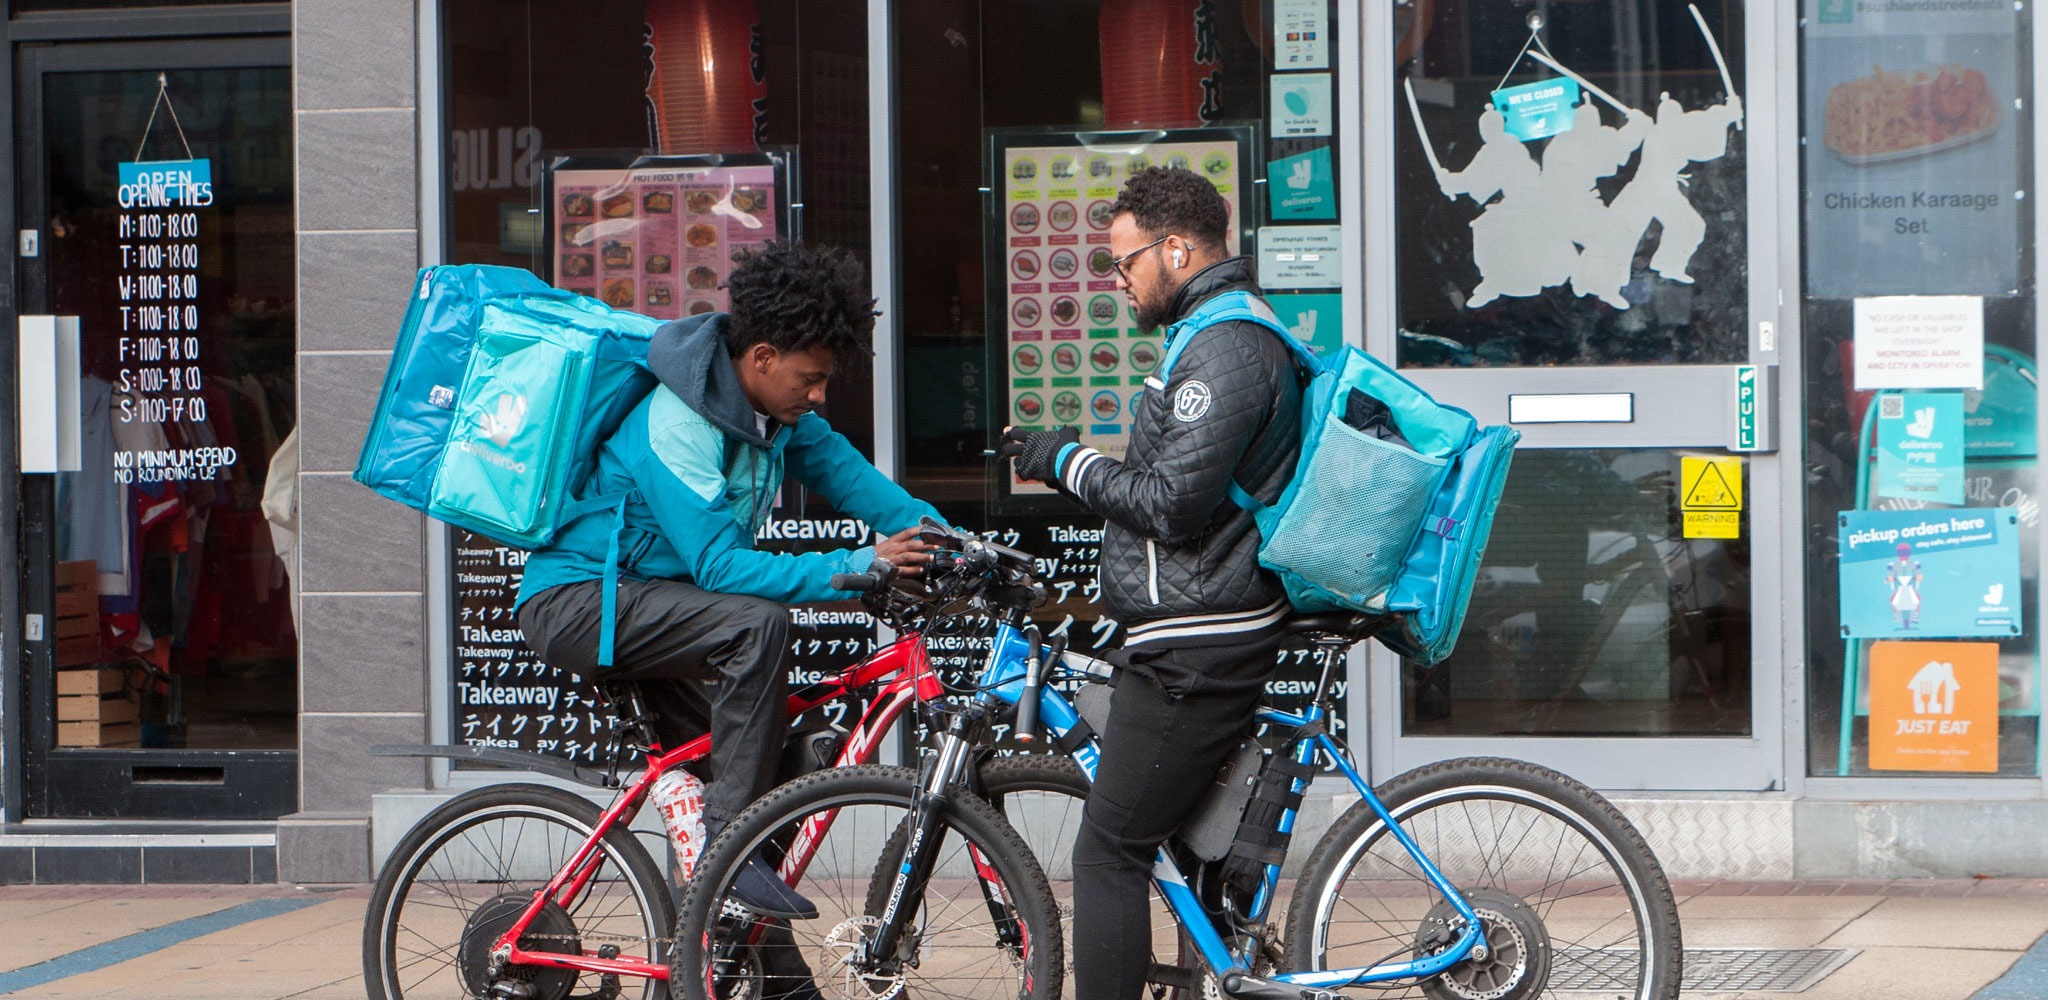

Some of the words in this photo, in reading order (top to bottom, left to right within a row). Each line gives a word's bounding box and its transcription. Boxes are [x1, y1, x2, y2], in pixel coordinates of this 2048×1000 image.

[138, 170, 192, 188] OPEN
[653, 173, 674, 181] FOOD
[1824, 191, 1906, 211] Chicken
[1912, 190, 1999, 212] Karaage
[1894, 217, 1929, 235] Set
[1869, 314, 1881, 322] NO
[1883, 314, 1906, 322] CASH
[1922, 313, 1969, 321] VALUABLES
[1891, 326, 1910, 334] LEFT
[1940, 325, 1963, 333] SHOP
[1892, 337, 1942, 346] OVERNIGHT
[1875, 350, 1929, 358] MONITORED
[1930, 349, 1962, 357] ALARM
[1866, 362, 1886, 370] AND
[1887, 362, 1909, 370] CCTV
[1921, 360, 1971, 369] OPERATION
[1180, 388, 1204, 416] 67
[1741, 386, 1753, 445] PULL
[1898, 439, 1944, 449] deliveroo
[114, 451, 133, 469] NO
[137, 449, 194, 468] MINIMUM
[195, 446, 237, 467] SPEND
[114, 468, 133, 484] NO
[138, 467, 197, 483] ROUNDING
[199, 467, 216, 481] UP
[1686, 513, 1737, 524] WARNING
[1848, 527, 1899, 549] pickup
[1900, 521, 1949, 539] orders
[1951, 516, 1985, 532] here
[457, 547, 494, 558] Takeaway
[457, 573, 508, 585] Takeaway
[789, 607, 875, 629] Takeaway
[457, 645, 514, 660] Takeaway
[791, 637, 878, 656] イクアウト
[457, 679, 559, 711] Takeaway
[461, 711, 602, 736] テイクアウト
[1895, 719, 1937, 736] JUST
[1938, 719, 1972, 736] EAT
